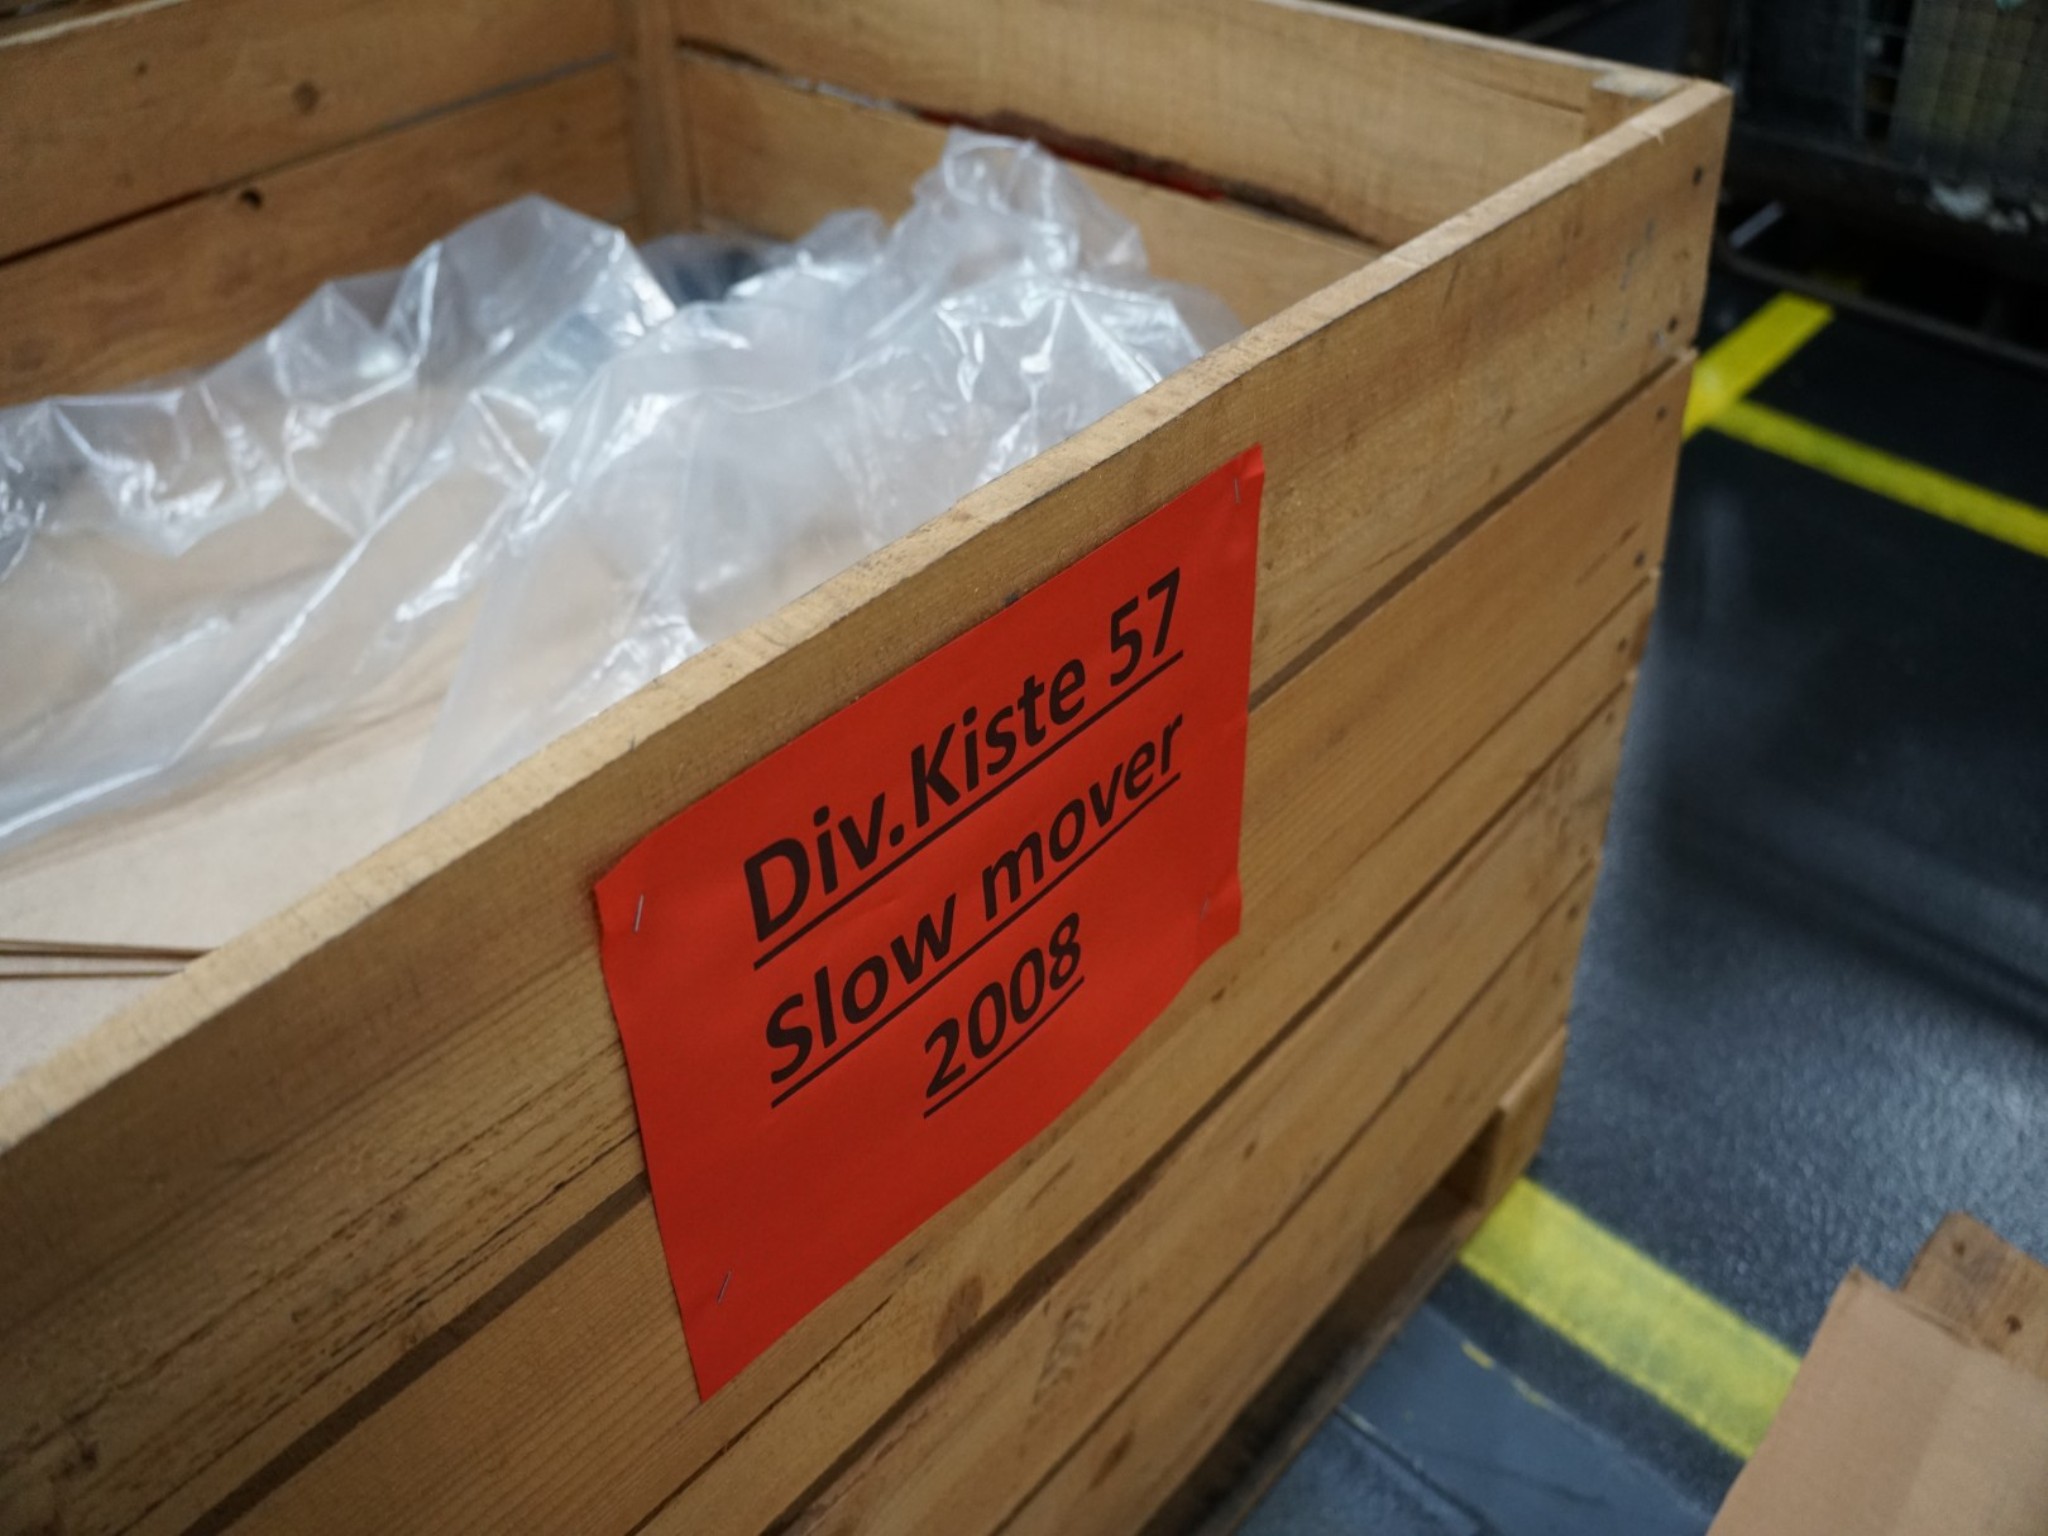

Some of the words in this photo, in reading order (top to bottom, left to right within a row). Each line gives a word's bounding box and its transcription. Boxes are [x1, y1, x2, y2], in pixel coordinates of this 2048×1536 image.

[743, 658, 1086, 943] Div.Kiste
[1110, 567, 1181, 687] 57
[765, 893, 956, 1085] Slow
[981, 713, 1183, 922] mover
[924, 911, 1081, 1099] 2008
